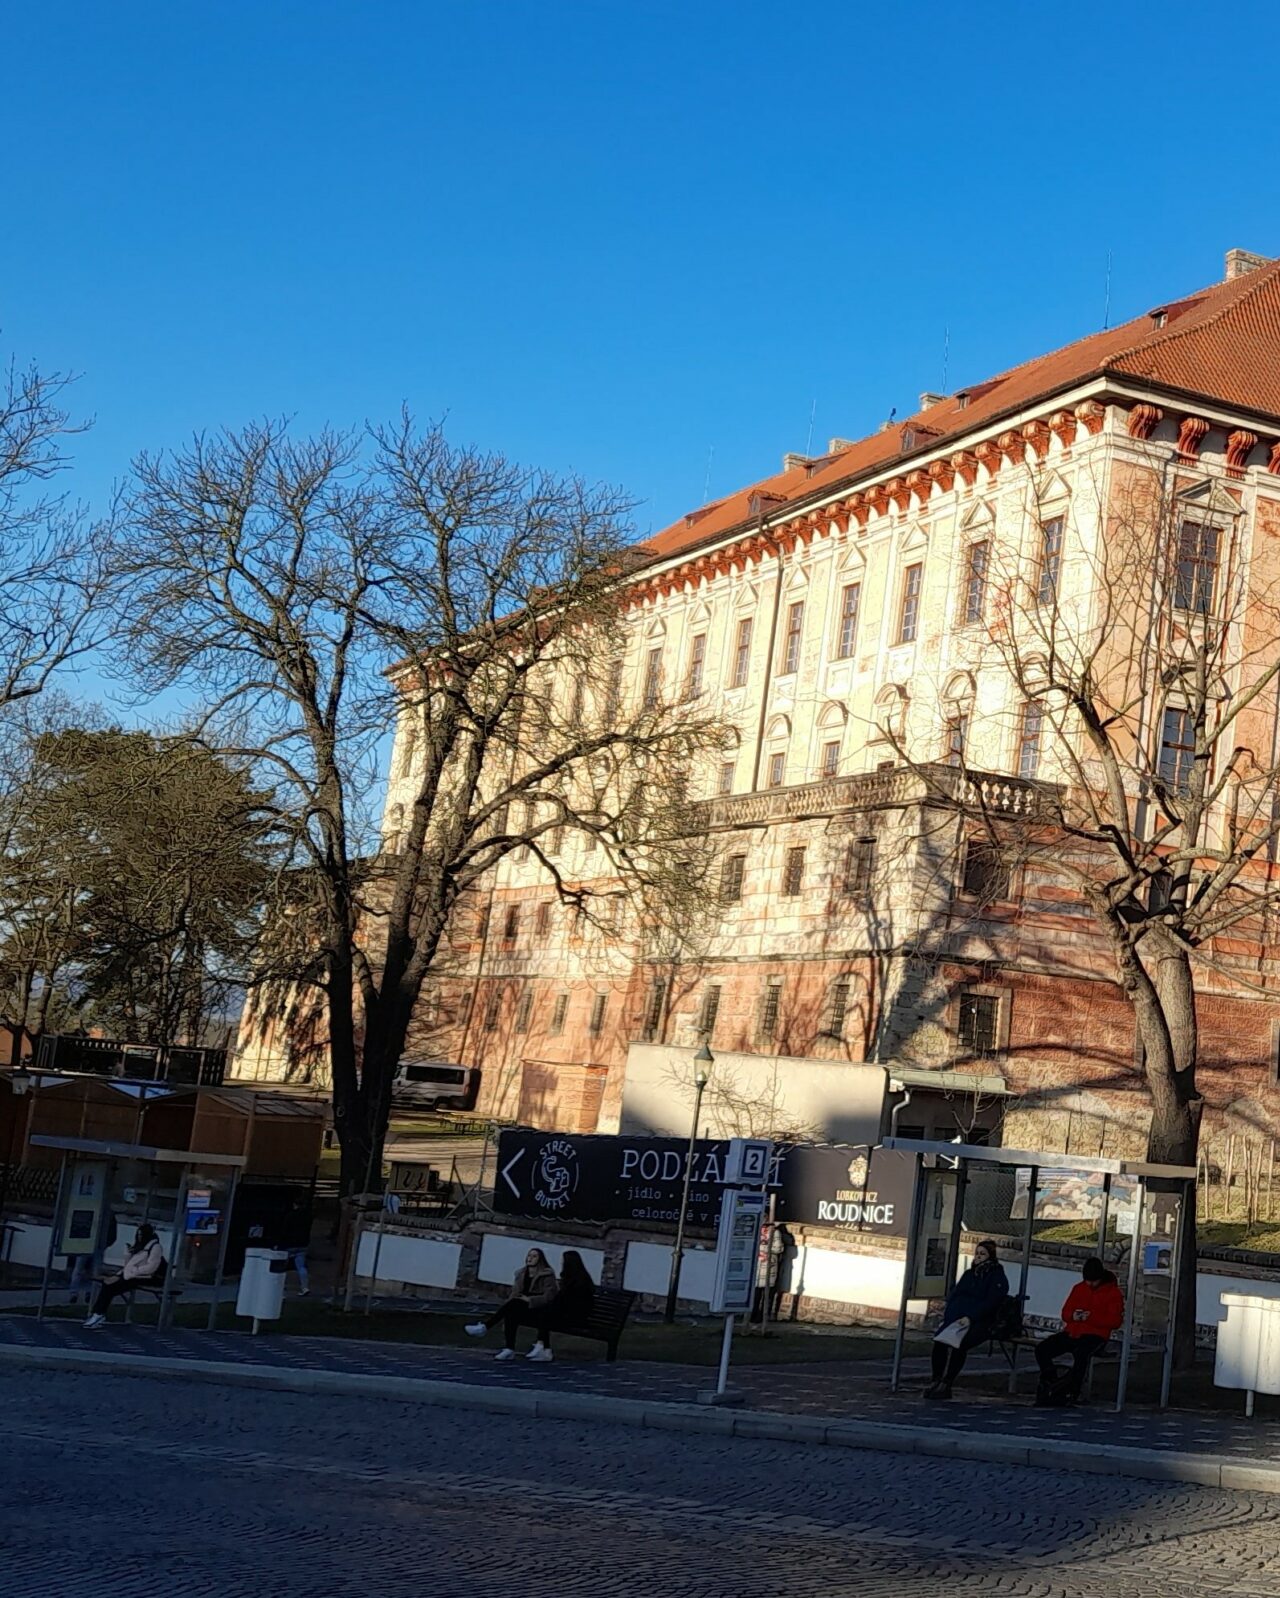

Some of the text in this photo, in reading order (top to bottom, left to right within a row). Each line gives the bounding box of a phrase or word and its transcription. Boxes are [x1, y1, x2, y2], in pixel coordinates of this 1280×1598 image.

[539, 1140, 577, 1160] STREET
[619, 1144, 786, 1187] PODZÁÍ
[749, 1153, 760, 1171] 2
[534, 1190, 571, 1211] BUFFET
[632, 1206, 694, 1221] celoročě
[700, 1213, 709, 1222] v
[817, 1200, 894, 1224] ROUDNICE
